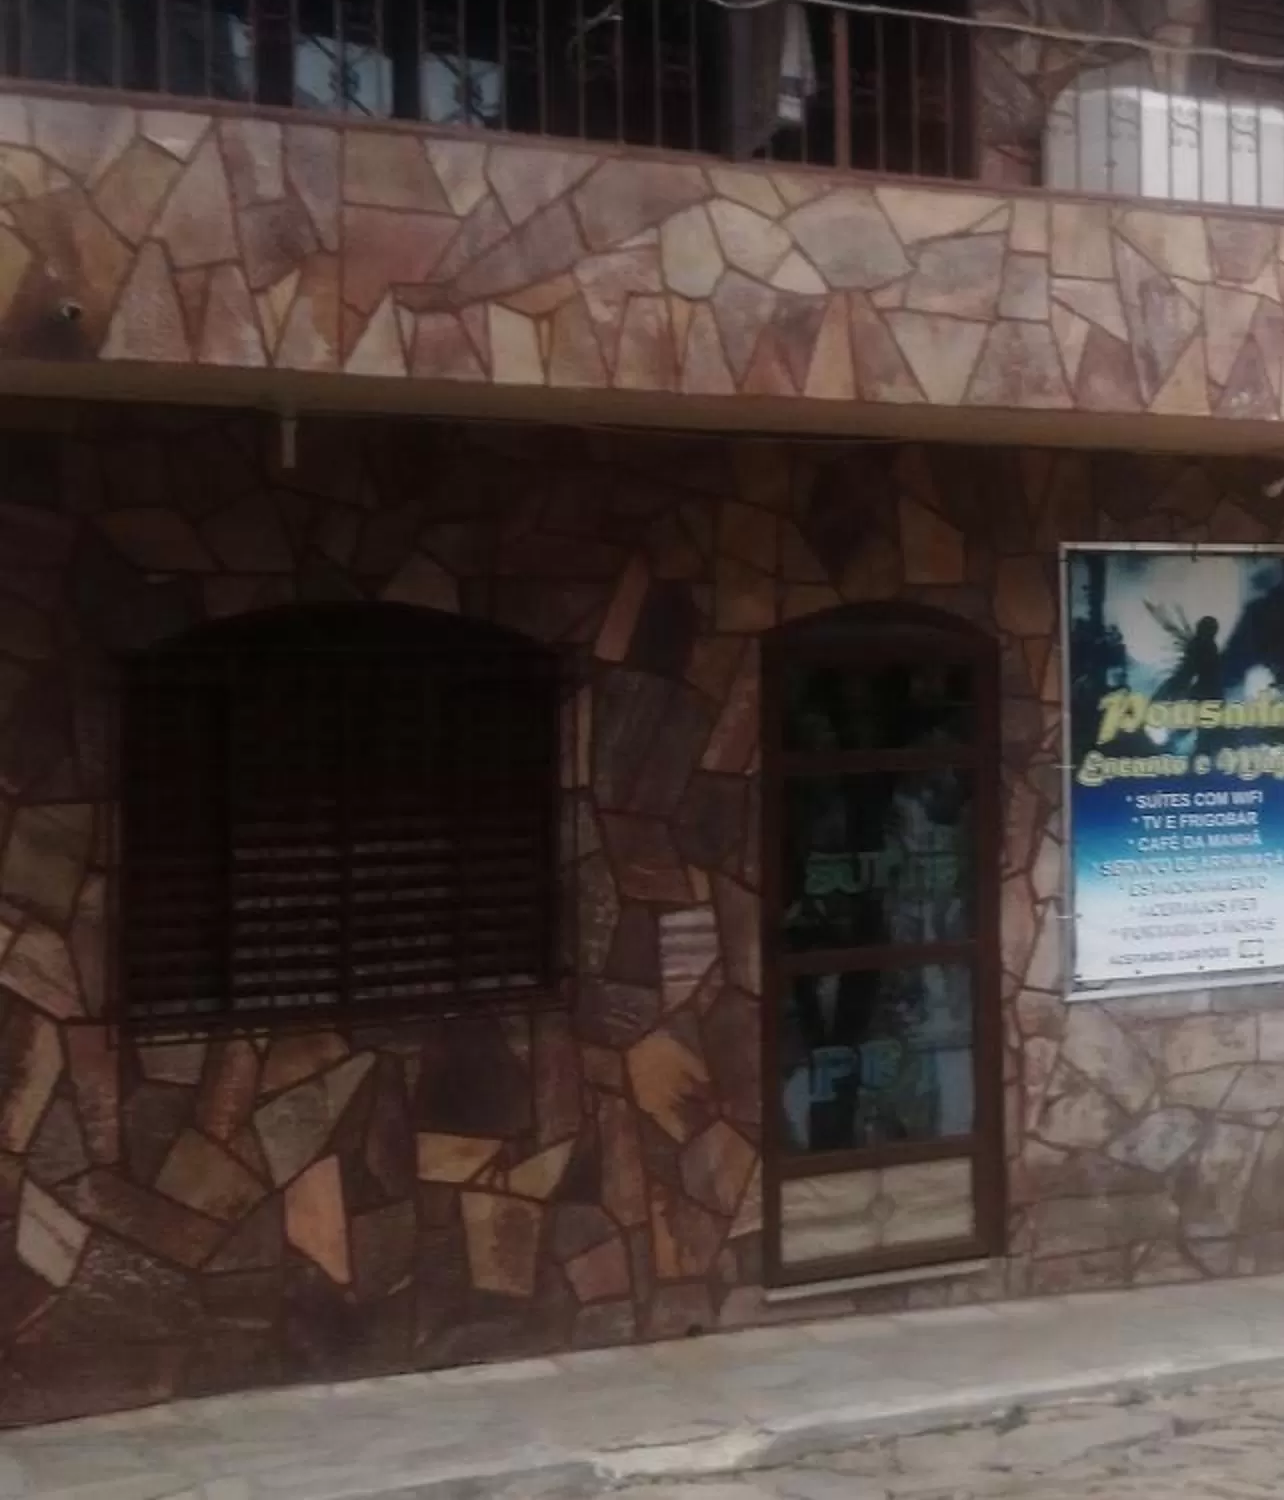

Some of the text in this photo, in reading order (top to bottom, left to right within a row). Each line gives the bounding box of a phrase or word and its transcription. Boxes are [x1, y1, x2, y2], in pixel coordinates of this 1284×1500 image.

[1076, 749, 1189, 787] Encanto
[1194, 753, 1211, 776] e
[1194, 791, 1228, 807] COM
[1231, 789, 1264, 805] WIFI
[1140, 811, 1259, 830] TV E FRIGOBAR
[1136, 833, 1180, 852] CAFÉ
[1183, 834, 1205, 850] DA
